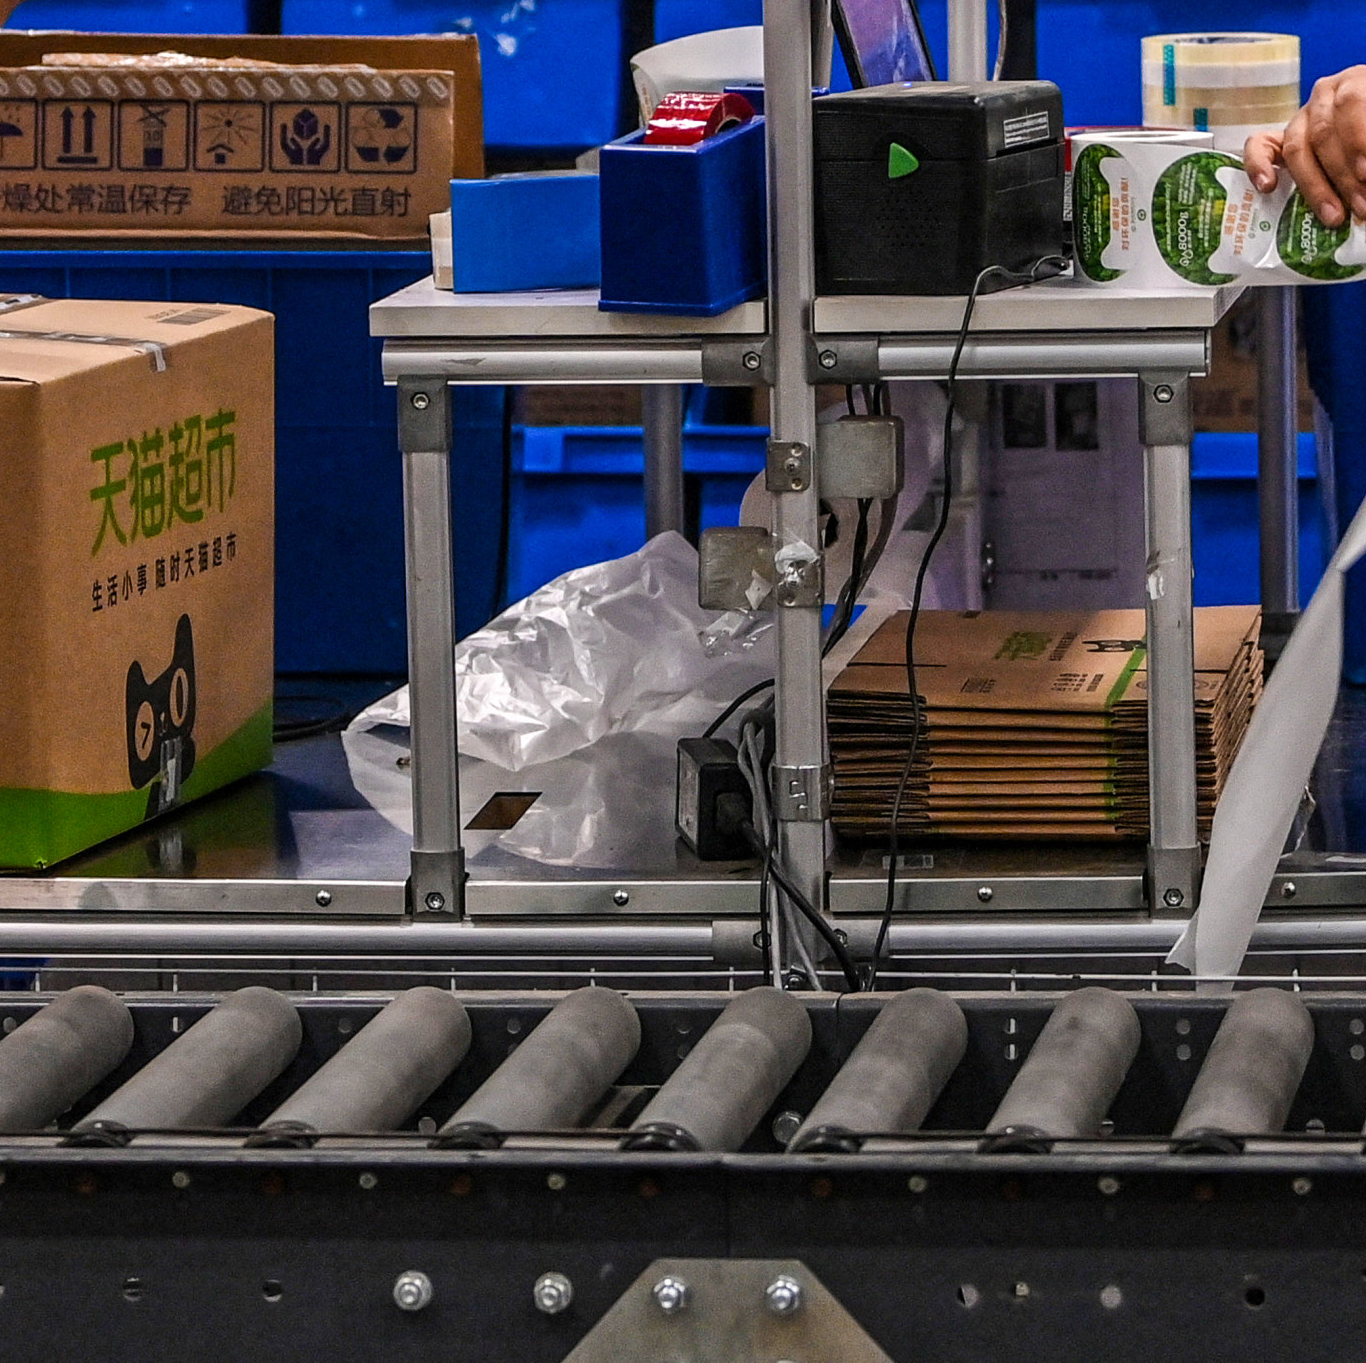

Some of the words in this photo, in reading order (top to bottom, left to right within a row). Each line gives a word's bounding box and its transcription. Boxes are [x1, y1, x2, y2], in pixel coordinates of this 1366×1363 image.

[222, 185, 412, 218] 避免阳光直射
[1177, 211, 1189, 251] 8000g
[90, 408, 237, 558] 天猫超市
[91, 562, 148, 613] 生活小事
[154, 531, 237, 590] 随时天猫超市
